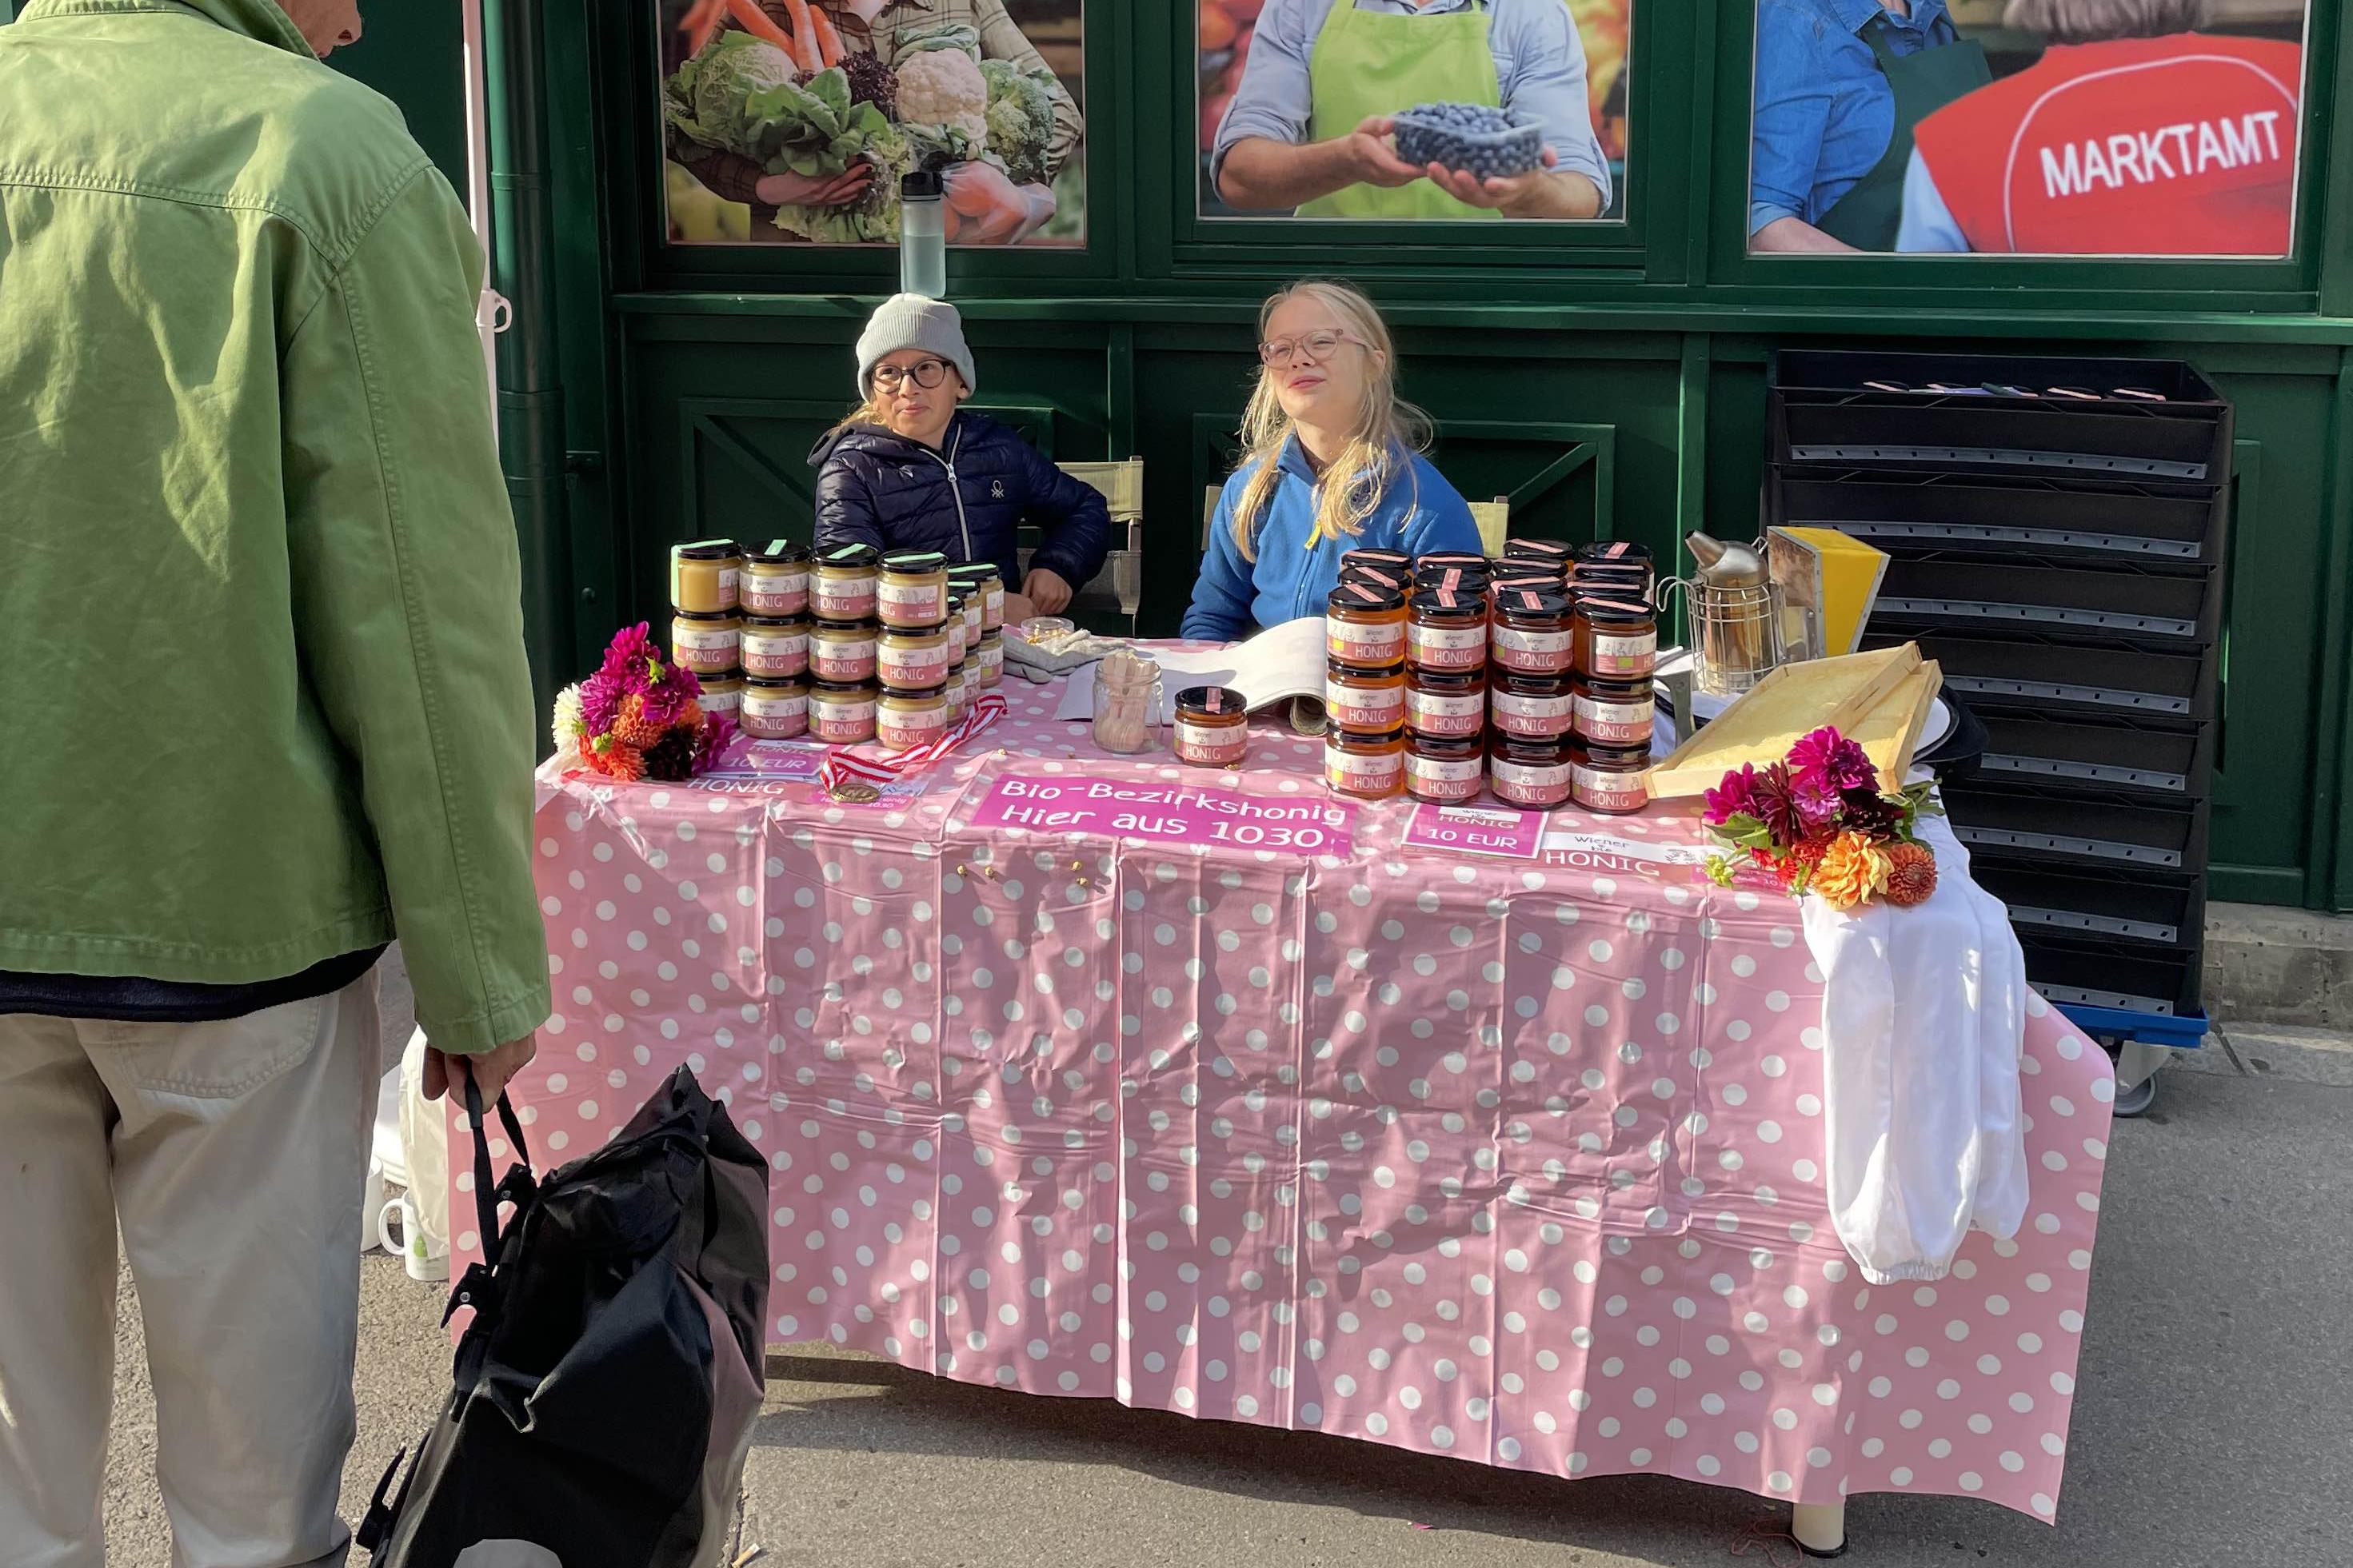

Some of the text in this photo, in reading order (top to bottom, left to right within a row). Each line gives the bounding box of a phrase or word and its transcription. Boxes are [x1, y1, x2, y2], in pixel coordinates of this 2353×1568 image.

[2039, 110, 2279, 197] MARKTAMT
[749, 593, 782, 608] HONIG
[818, 596, 849, 611] HONIG
[878, 604, 896, 616] NIG
[685, 650, 720, 662] HONIG
[1356, 645, 1392, 658] HONIG
[1434, 650, 1472, 663] HONIG
[750, 656, 784, 669] HONIG
[824, 660, 858, 673] HONIG
[1515, 653, 1555, 667] HONIG
[889, 668, 925, 680] HONIG
[1348, 709, 1387, 723] HONIG
[1434, 716, 1472, 730] HONIG
[750, 717, 785, 731] HONIG
[826, 723, 861, 735] HONIG
[1508, 716, 1547, 732] HONIG
[1590, 723, 1630, 738] HONIG
[889, 731, 925, 743] HONIG
[1185, 745, 1221, 760] HONIG
[763, 758, 807, 768] EUR
[687, 777, 787, 795] HONIG
[1354, 775, 1392, 788] HONIG
[1428, 781, 1466, 795] HONIG
[1507, 785, 1546, 800] HONIG
[1589, 792, 1629, 806] HONIG
[1001, 780, 1347, 825] Bio-Bezirkshonig
[1001, 804, 1324, 848] Hier aus 1030
[1439, 814, 1514, 829] HONIG
[1426, 828, 1517, 850] 10 EUR
[1574, 836, 1630, 848] Wiener
[1545, 851, 1660, 876] HONIG
